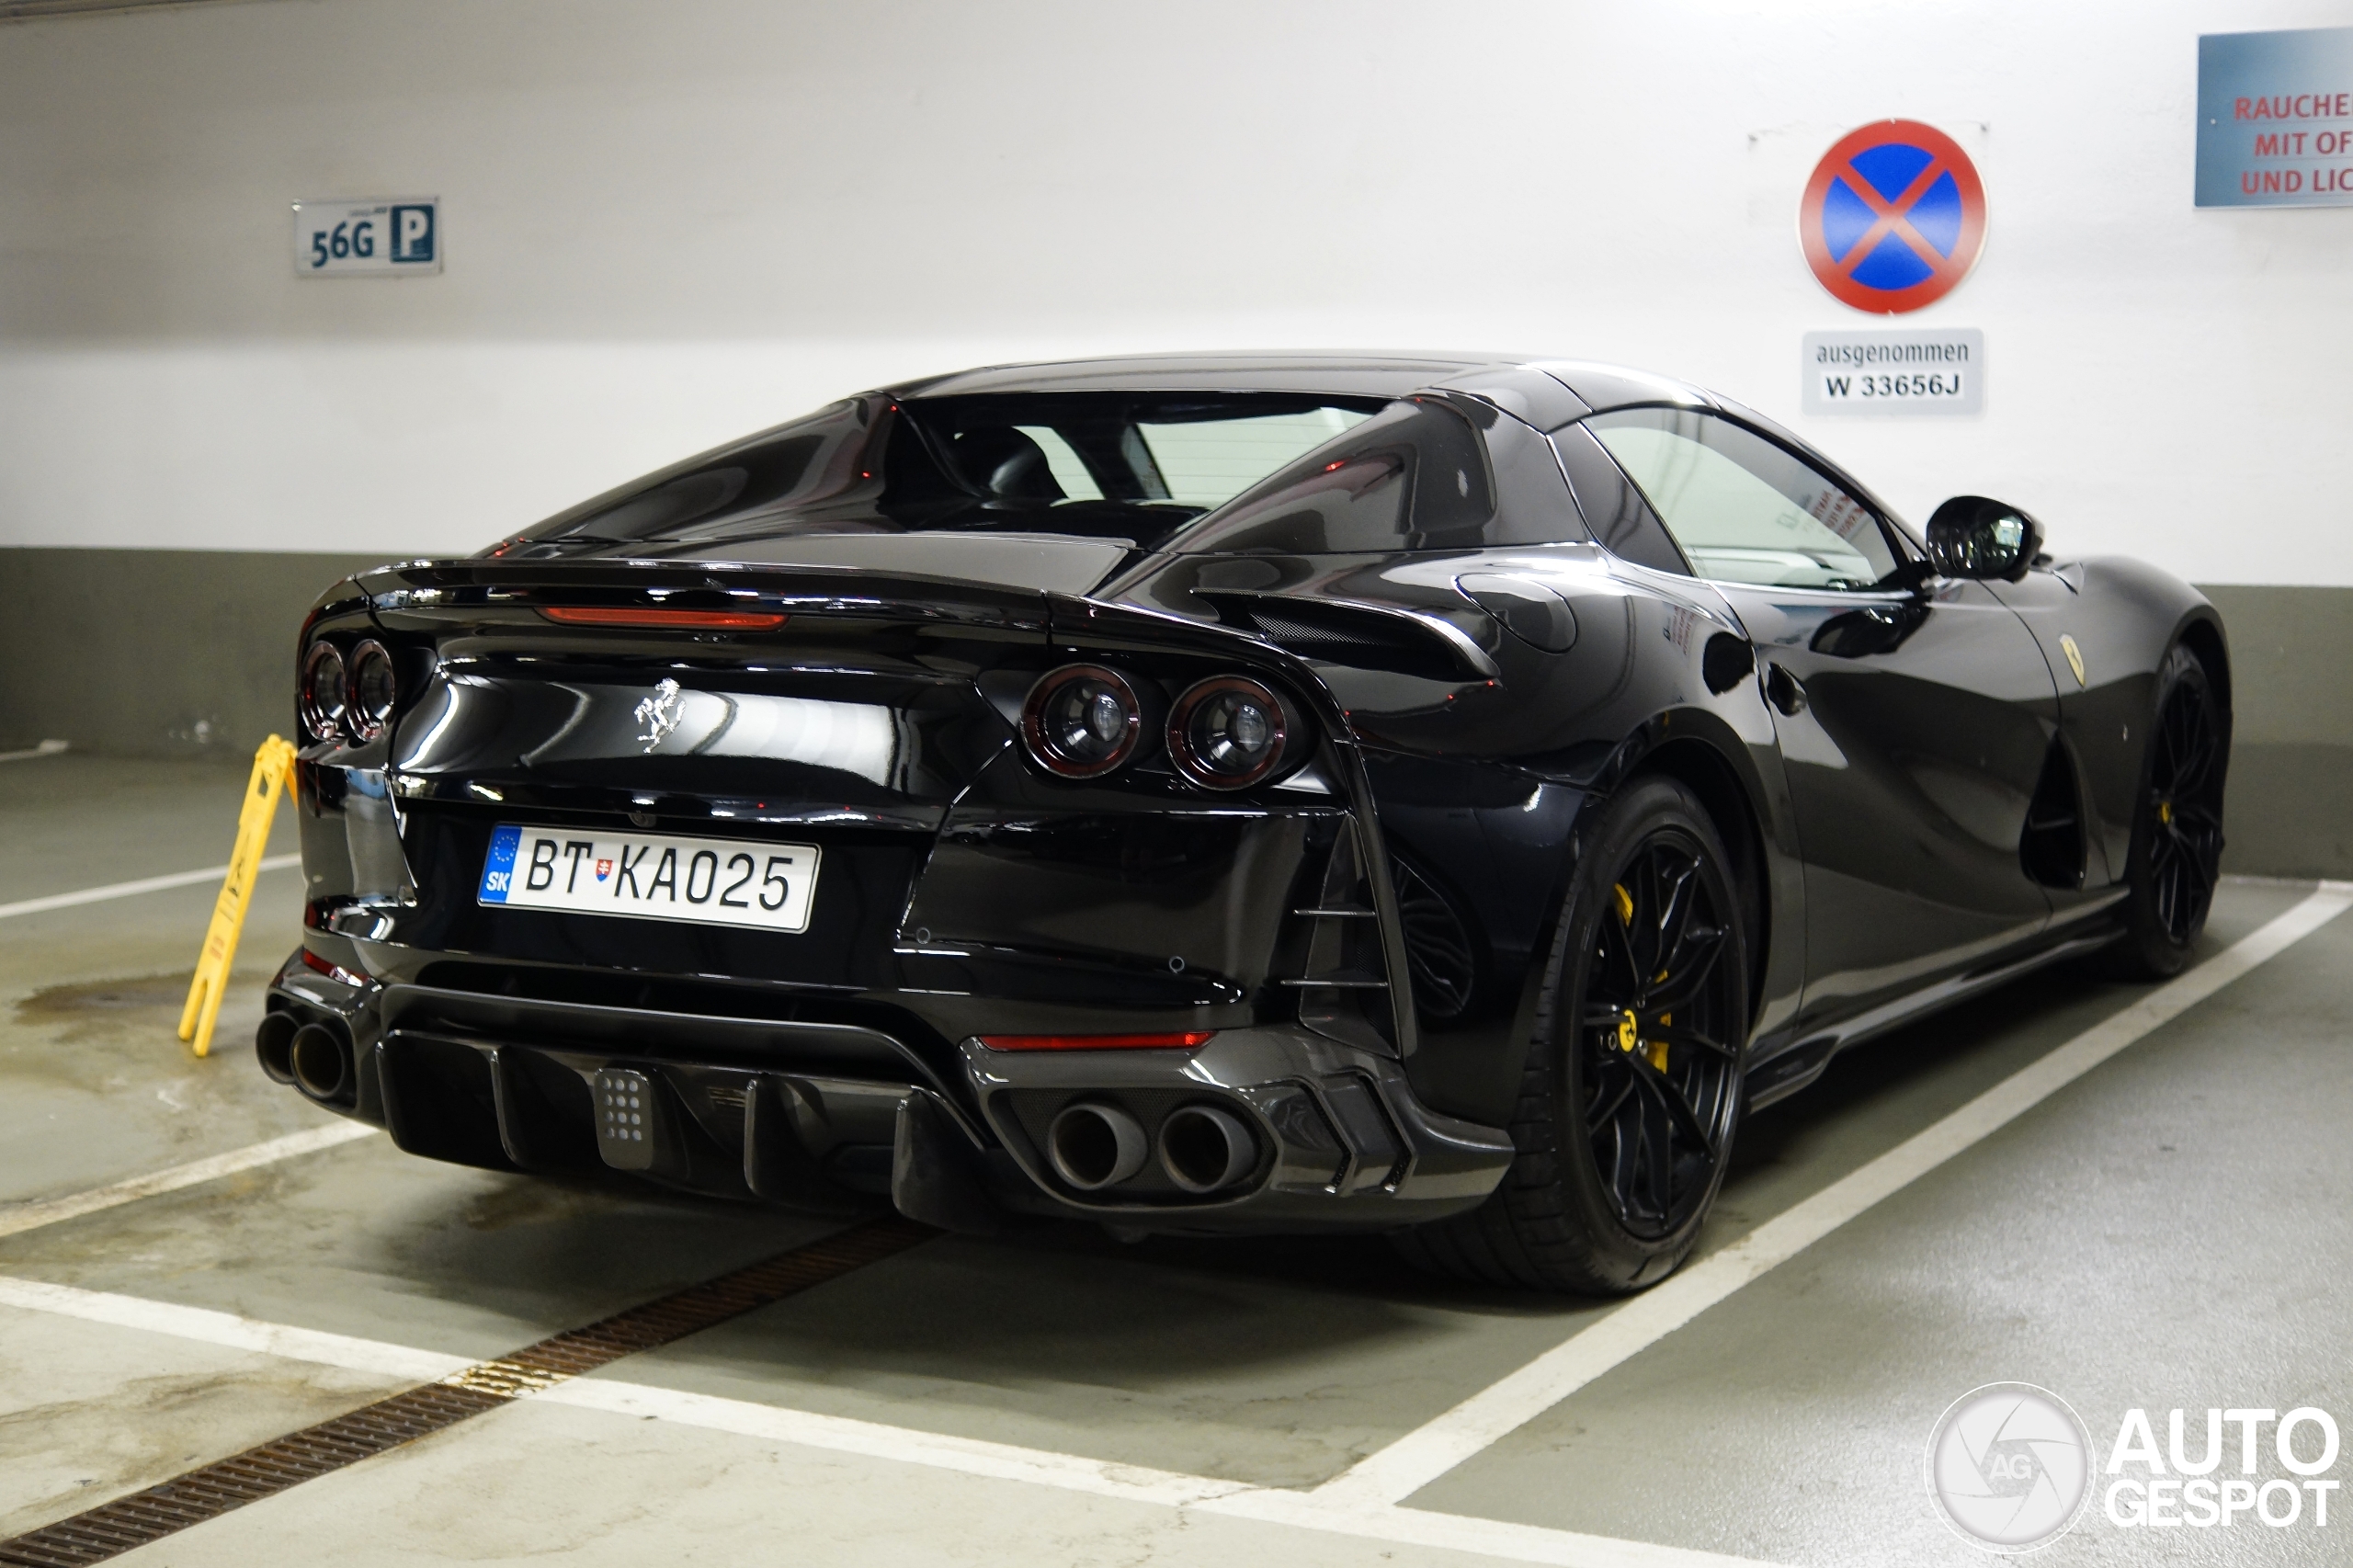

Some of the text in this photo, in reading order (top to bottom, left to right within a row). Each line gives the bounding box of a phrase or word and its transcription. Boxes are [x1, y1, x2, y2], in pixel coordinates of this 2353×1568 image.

[2234, 94, 2353, 120] RAUCHE
[2255, 132, 2309, 156] MIT
[2241, 169, 2303, 195] UND
[311, 209, 428, 268] 56G P
[1816, 343, 1969, 369] ausgenommen
[1825, 373, 1961, 399] W 33656J
[485, 870, 511, 892] SK
[525, 838, 793, 912] BT KA025
